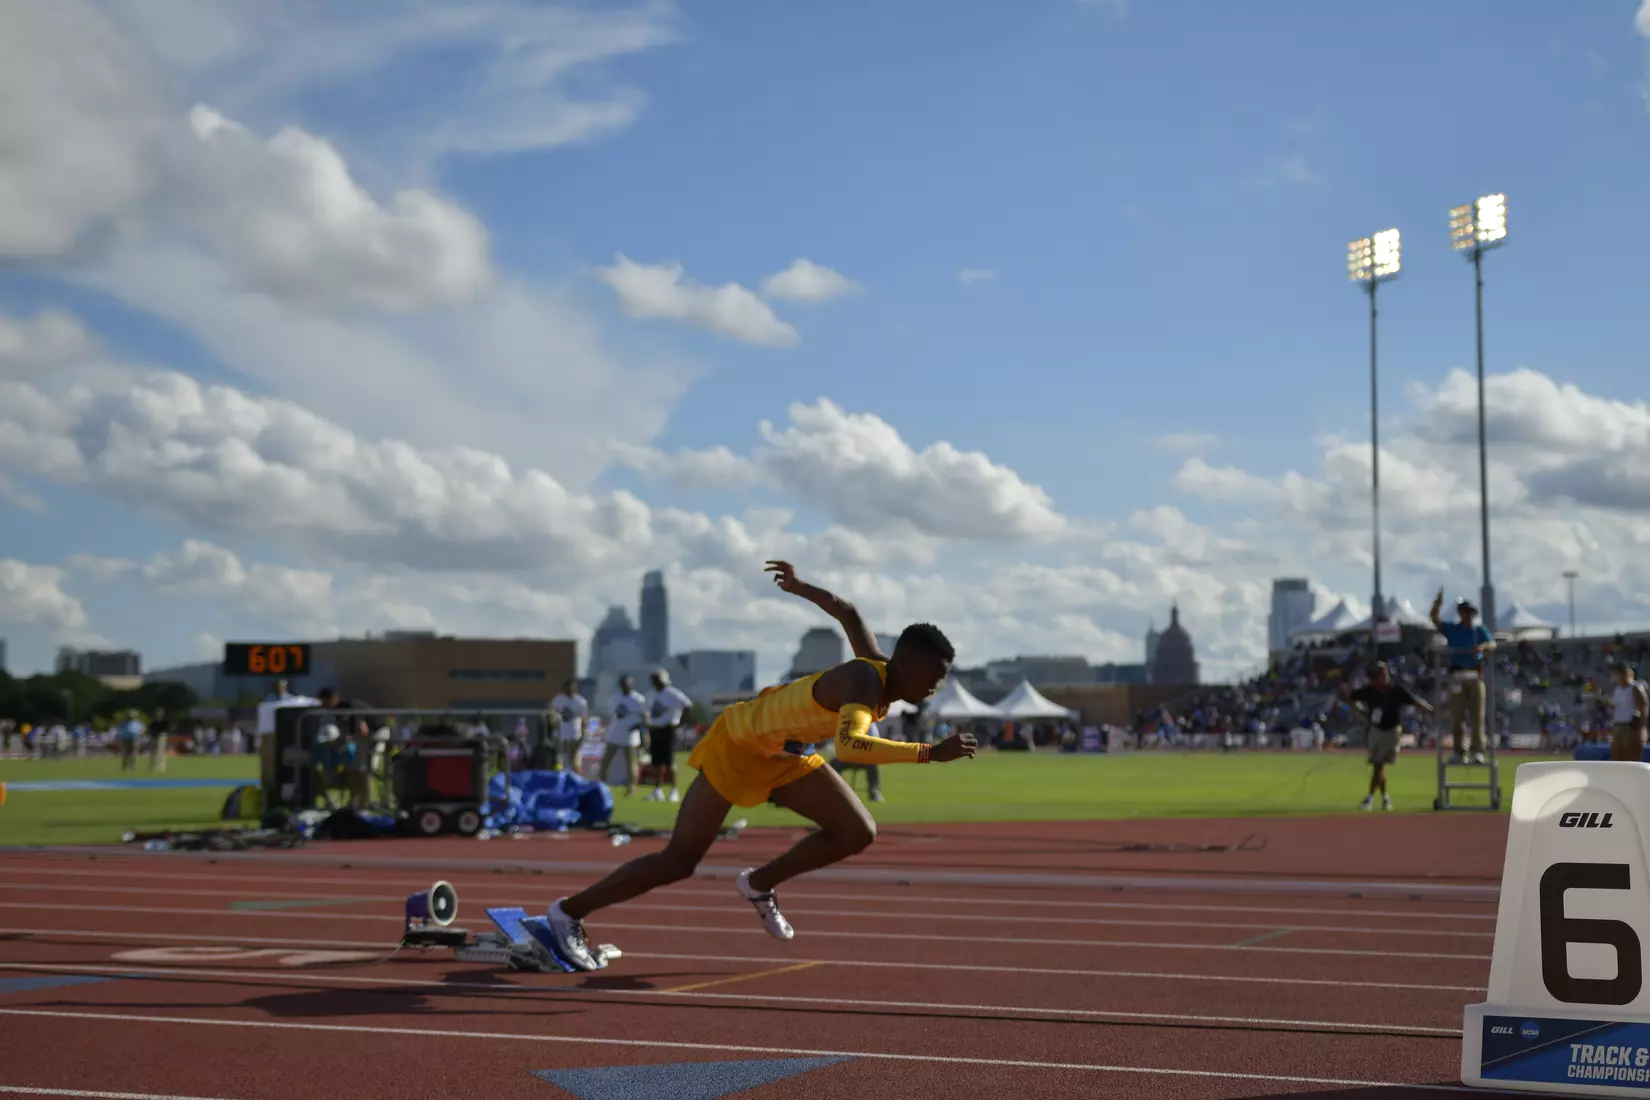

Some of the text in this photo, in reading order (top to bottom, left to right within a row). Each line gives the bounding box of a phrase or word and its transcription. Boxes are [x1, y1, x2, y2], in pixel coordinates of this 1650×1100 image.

[1559, 812, 1614, 829] GILL
[1539, 862, 1643, 1006] 6
[1490, 1026, 1514, 1035] GILL
[1570, 1044, 1650, 1067] TRACK &
